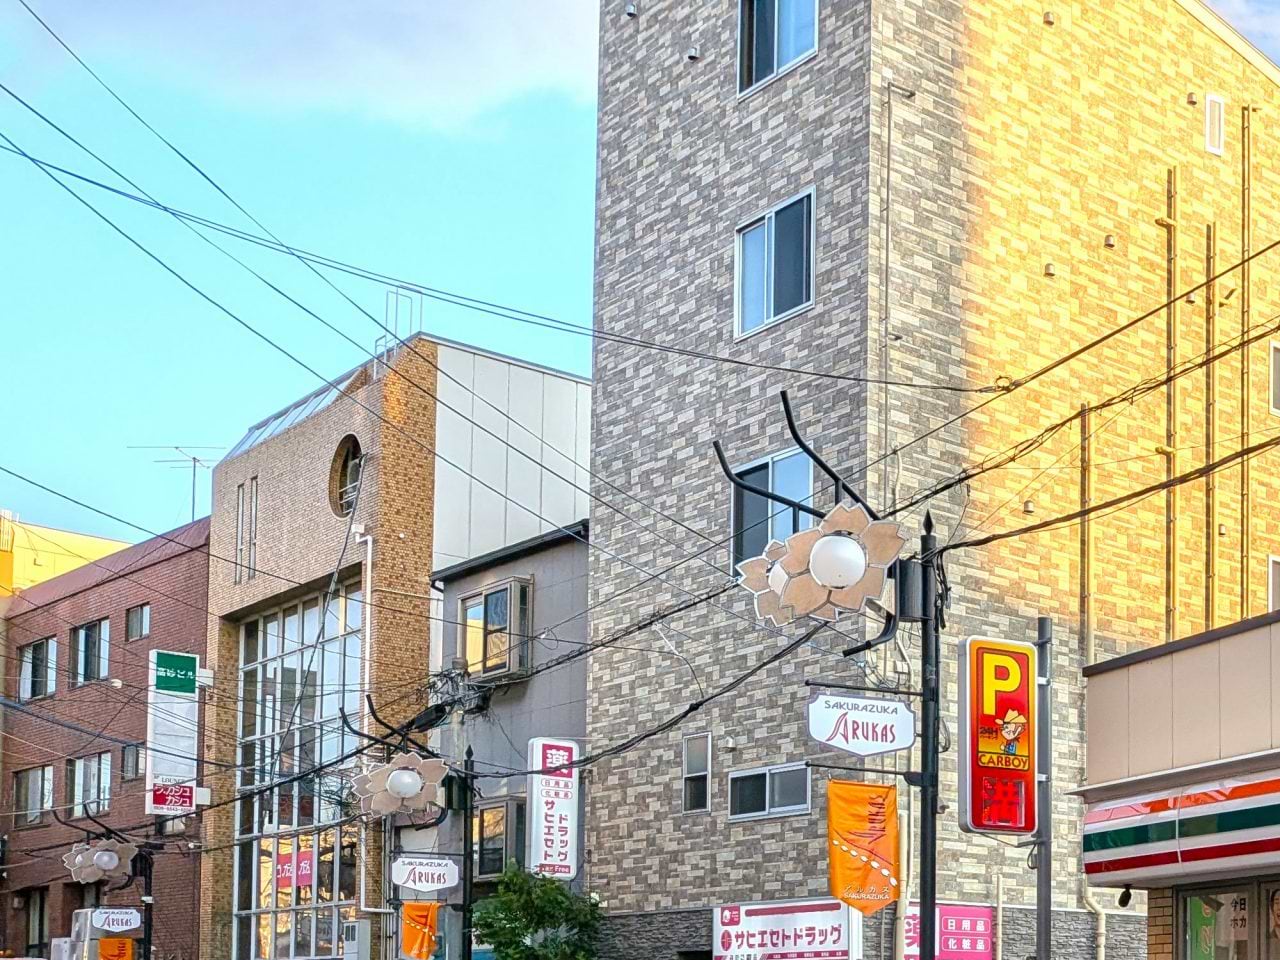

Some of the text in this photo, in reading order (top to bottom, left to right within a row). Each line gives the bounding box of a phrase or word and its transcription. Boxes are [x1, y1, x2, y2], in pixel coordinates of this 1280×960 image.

[983, 653, 1022, 716] P
[824, 700, 898, 715] SAKURAZUKA
[825, 712, 896, 744] ARUKAS
[978, 754, 1029, 770] CARBOY
[544, 800, 555, 861] サヒエセト
[557, 814, 569, 862] ドラッグ
[402, 860, 449, 868] SAKURAZUKA
[402, 866, 447, 886] ARUKAS
[947, 919, 985, 932] 日用品
[734, 923, 842, 949] サヒエセトドラッグ
[947, 938, 985, 950] 化粧品
